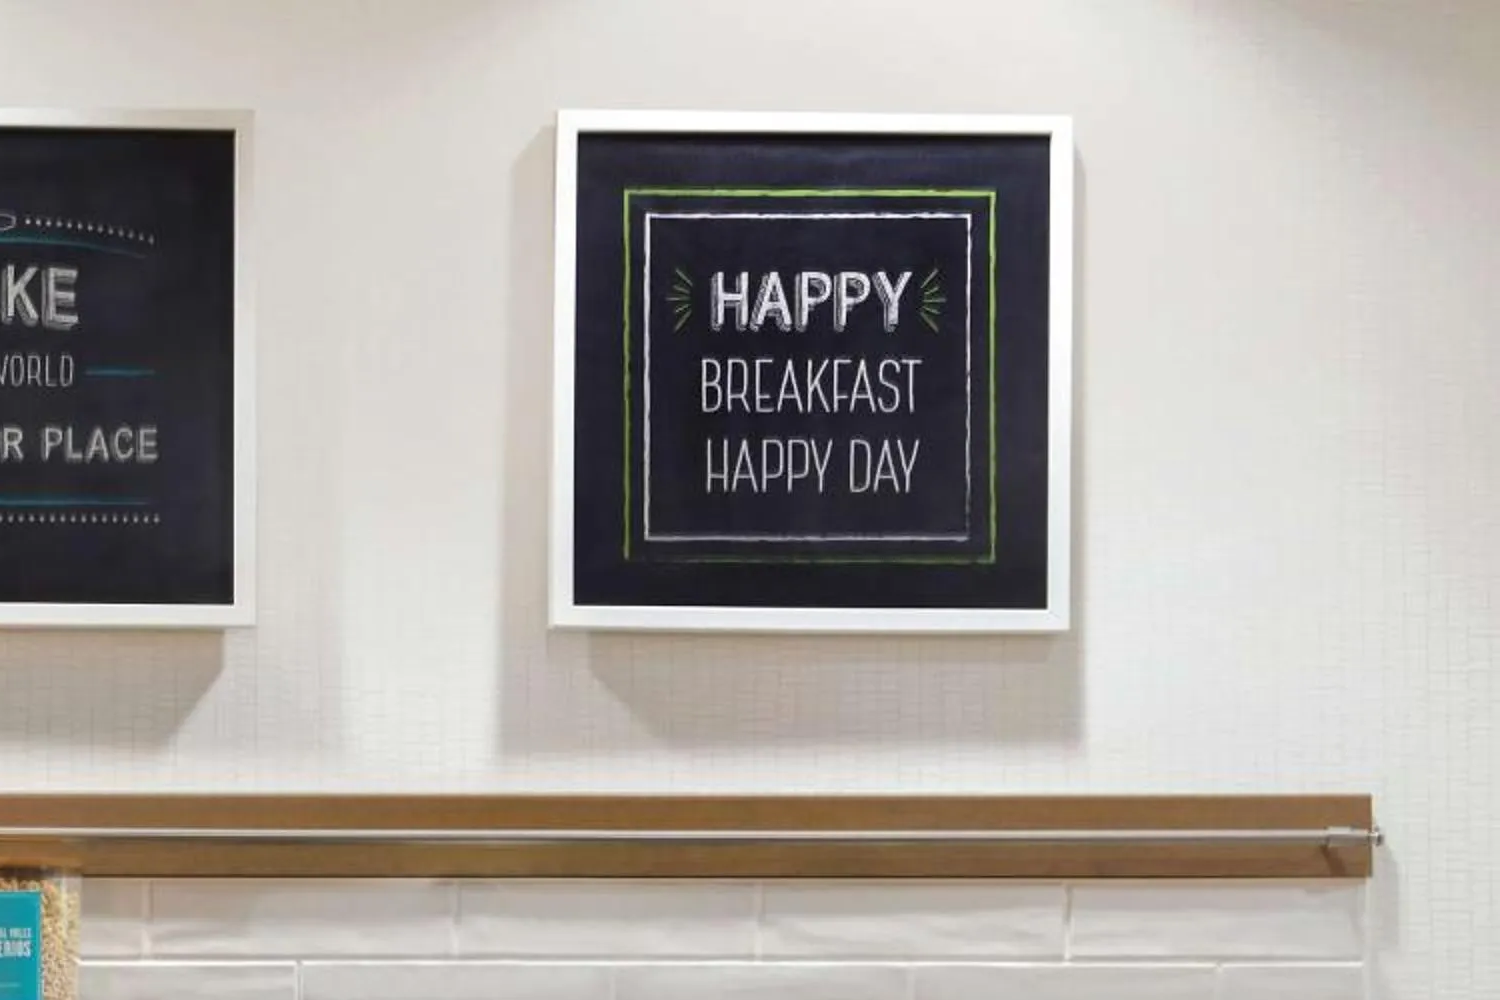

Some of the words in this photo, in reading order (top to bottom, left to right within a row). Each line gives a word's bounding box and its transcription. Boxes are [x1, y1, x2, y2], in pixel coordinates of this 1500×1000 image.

[710, 270, 913, 333] HAPPY
[701, 358, 923, 414] BREAKFAST
[41, 427, 159, 463] PLACE
[706, 438, 833, 493] HAPPY
[849, 438, 920, 493] DAY
